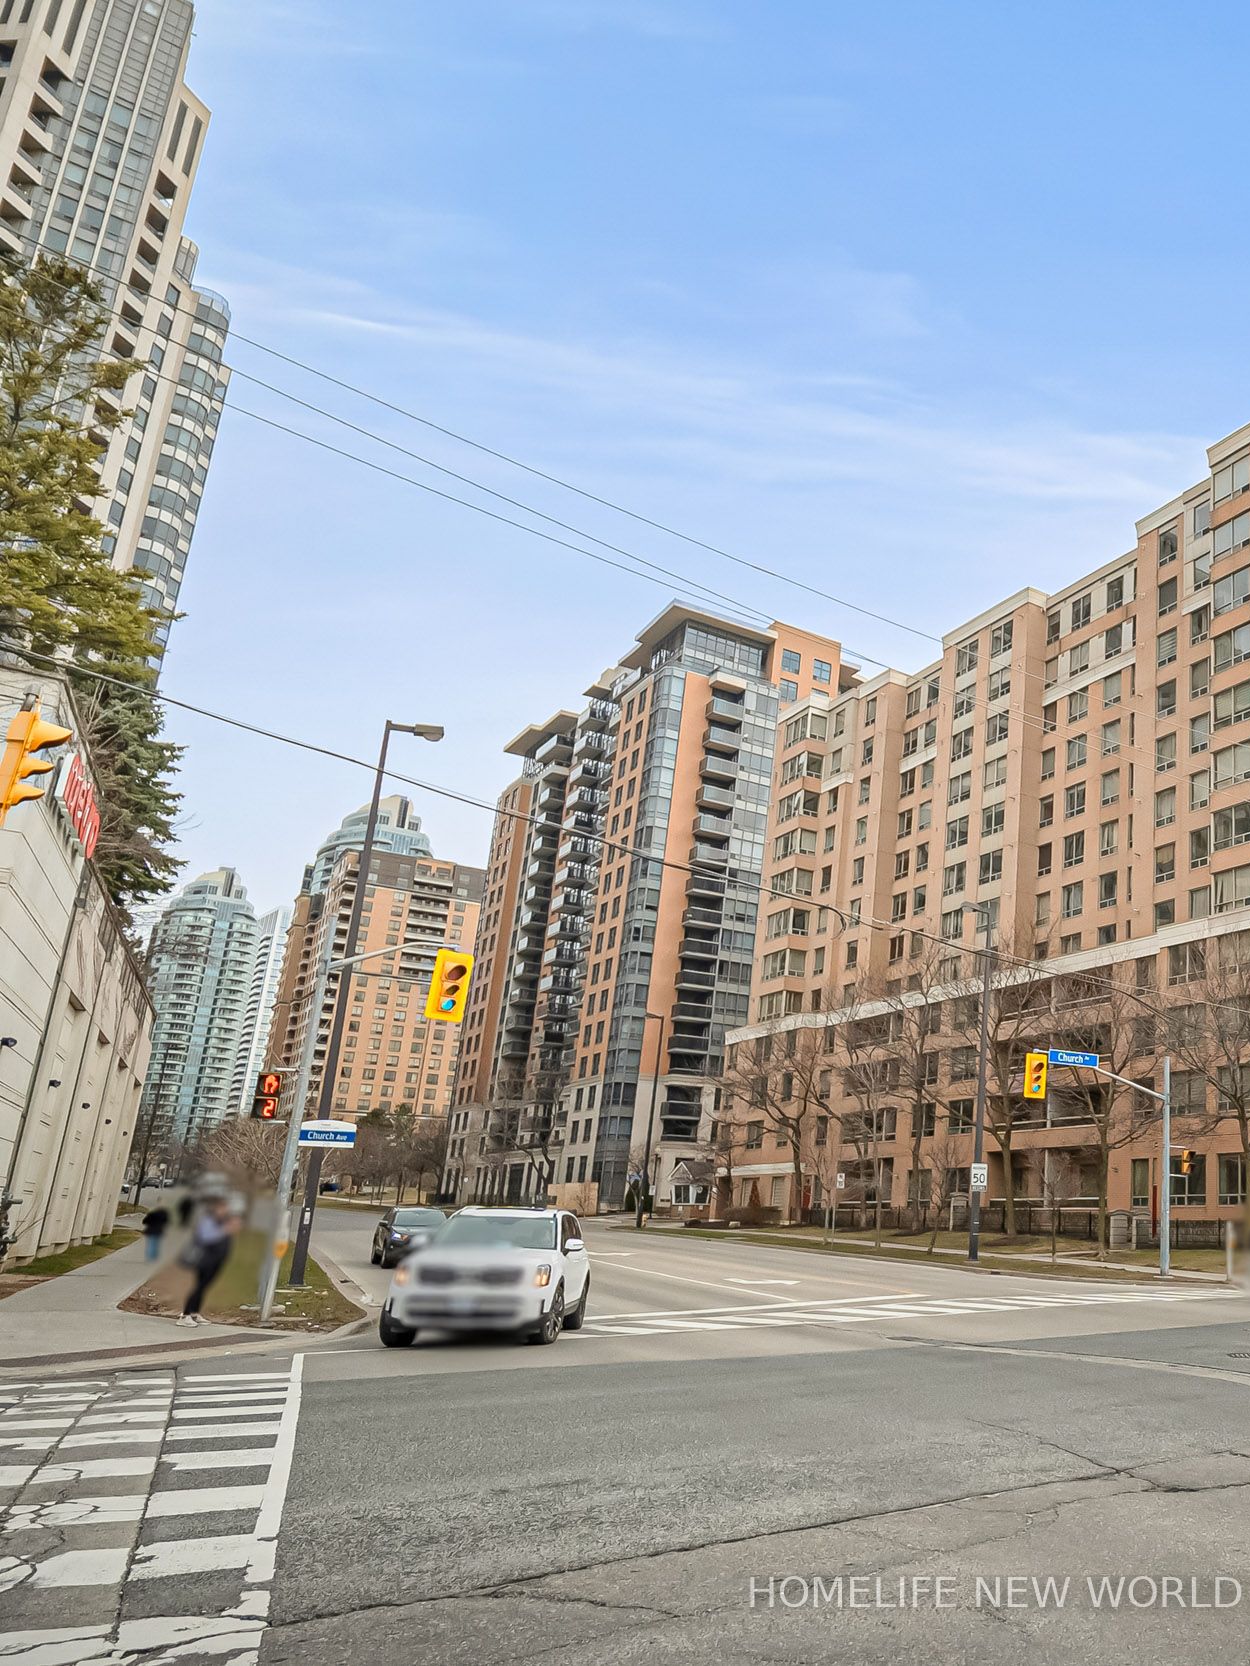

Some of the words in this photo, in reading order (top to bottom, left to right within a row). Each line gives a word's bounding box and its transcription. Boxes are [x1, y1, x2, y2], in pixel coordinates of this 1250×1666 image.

[1057, 1052, 1084, 1063] Church
[263, 1099, 275, 1117] 2
[307, 1131, 335, 1140] Church
[335, 1133, 348, 1141] Ave
[973, 1173, 985, 1183] 50
